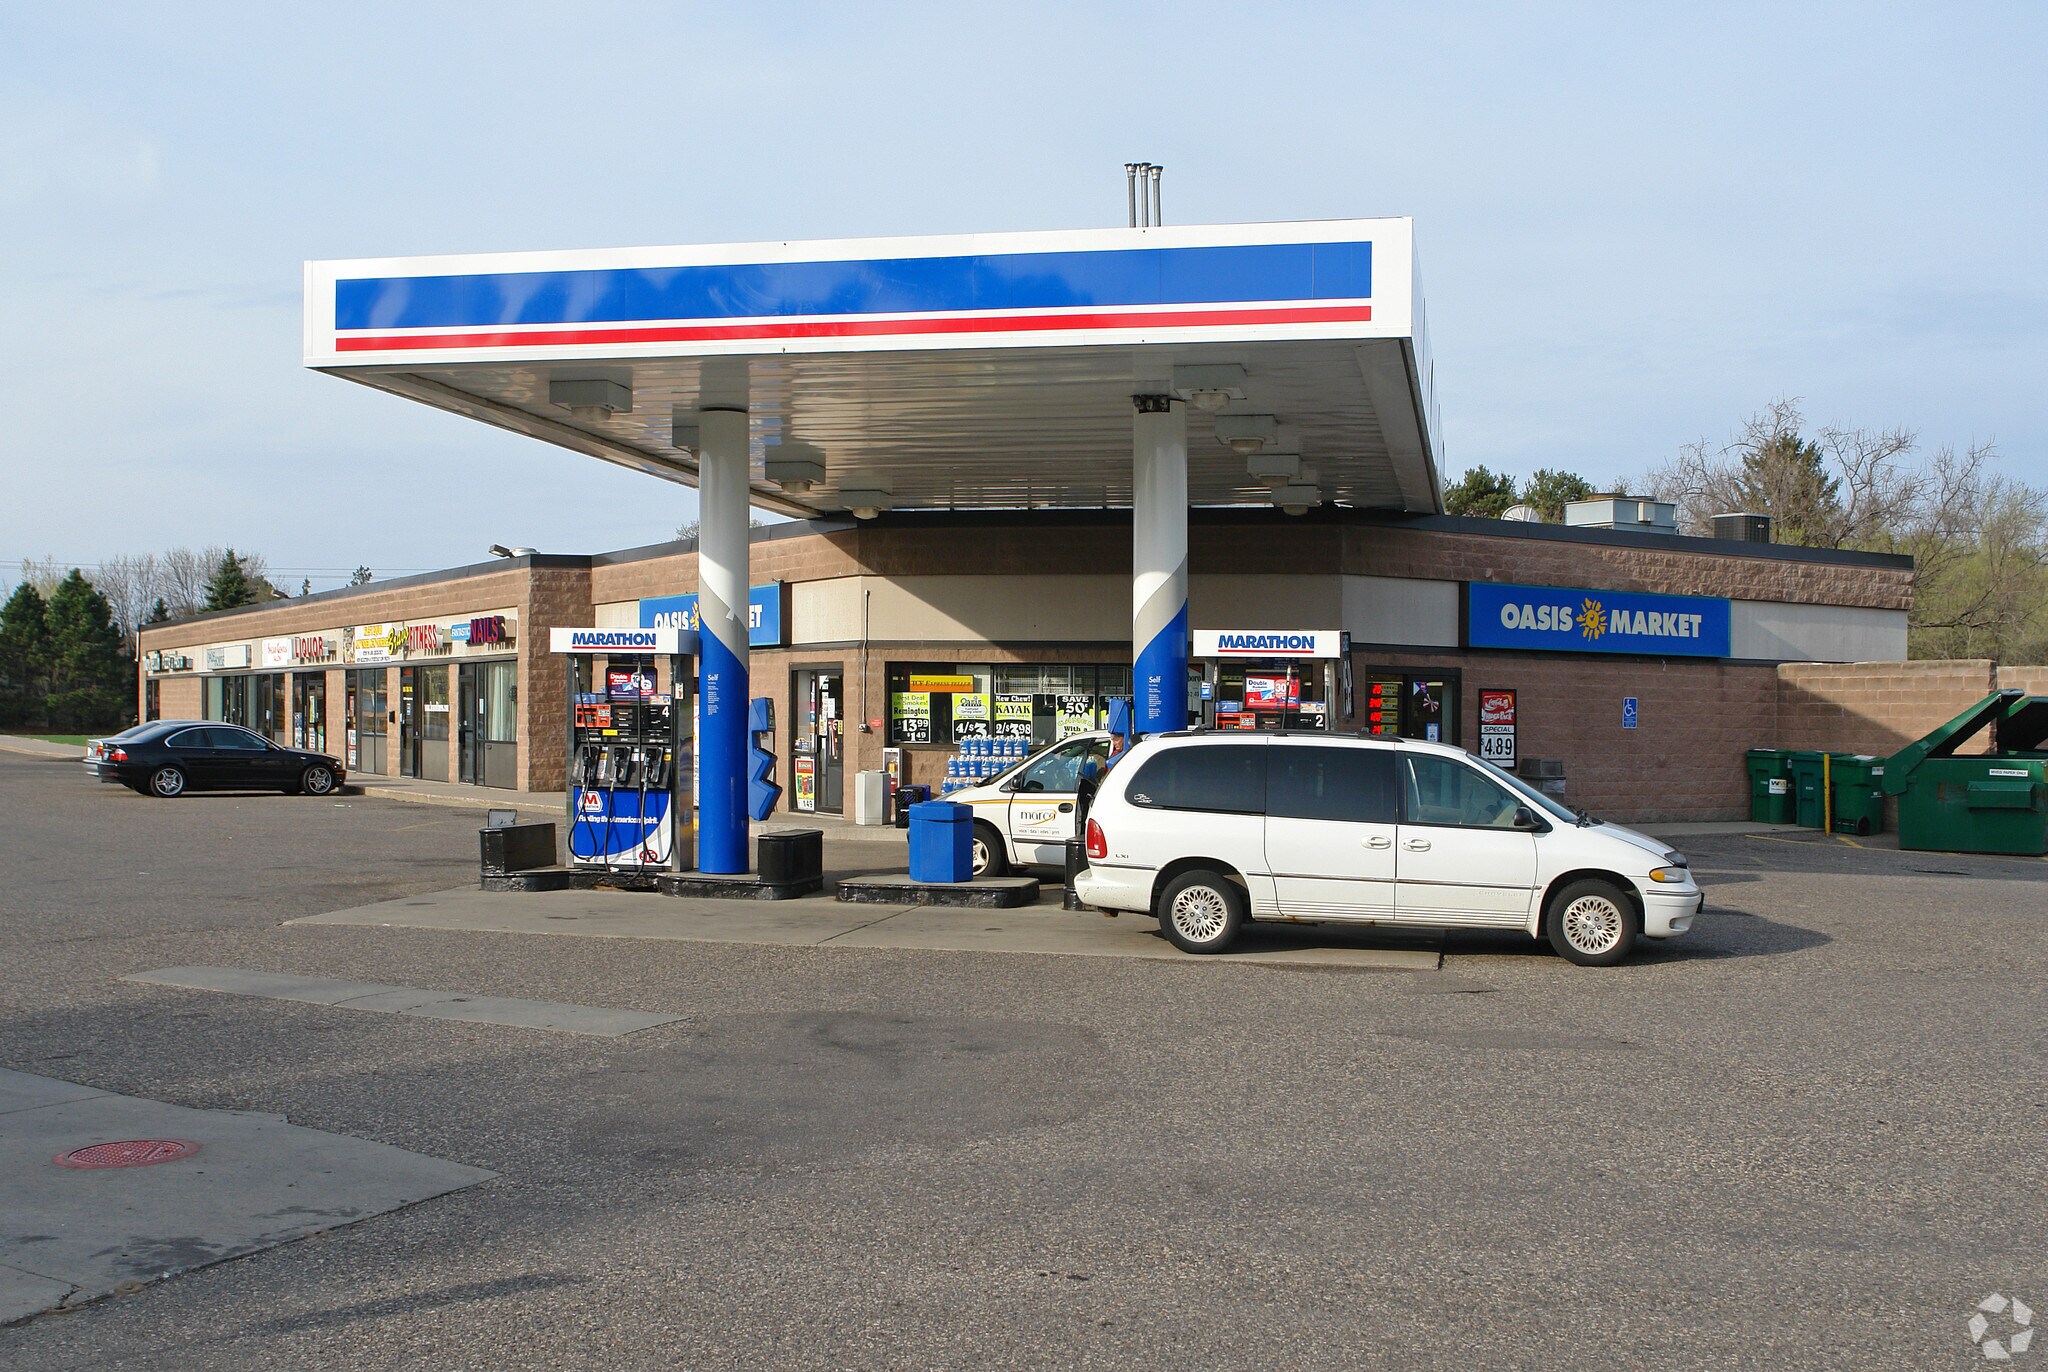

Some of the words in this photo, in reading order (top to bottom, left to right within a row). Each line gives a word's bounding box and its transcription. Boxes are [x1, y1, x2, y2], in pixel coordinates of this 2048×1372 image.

[654, 610, 689, 630] OASIS
[1501, 603, 1573, 631] OASIS
[1610, 610, 1702, 638] MARKET
[470, 615, 499, 645] NAILS
[409, 624, 437, 650] FITNESS
[572, 632, 656, 646] MARATHON
[1218, 635, 1315, 649] MARATHON
[295, 636, 323, 658] LIQUOR
[1149, 675, 1161, 683] Self
[661, 706, 670, 718] 4
[894, 707, 928, 717] Remington
[996, 705, 1031, 714] KAYAK
[1315, 714, 1324, 727] 2
[584, 794, 598, 805] M
[578, 815, 600, 823] Fuling
